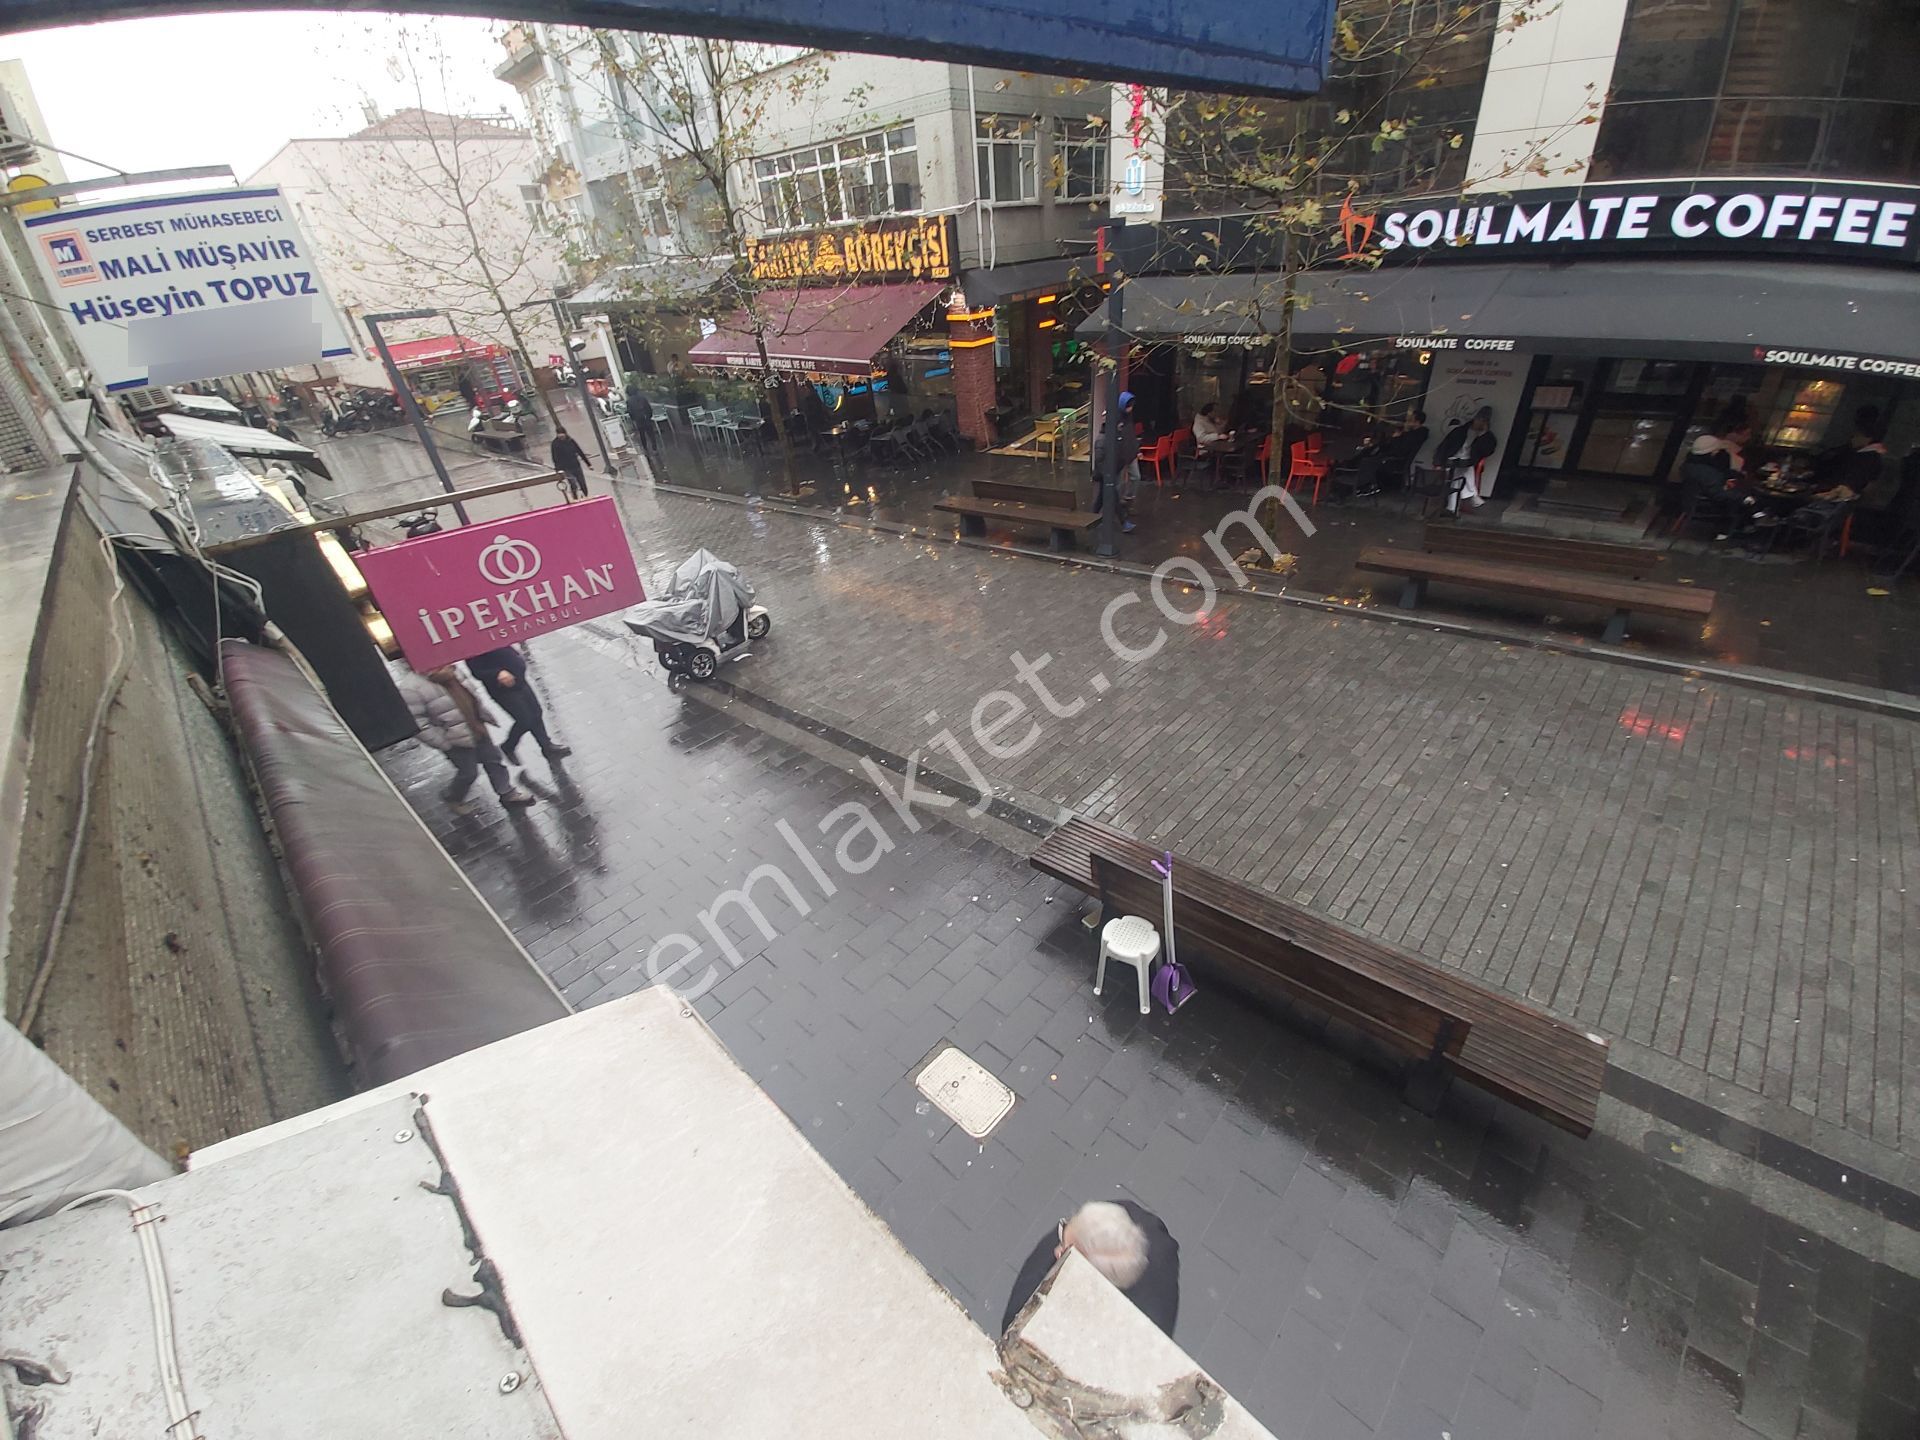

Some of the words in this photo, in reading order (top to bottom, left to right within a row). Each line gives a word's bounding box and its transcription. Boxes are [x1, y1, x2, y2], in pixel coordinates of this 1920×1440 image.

[86, 220, 165, 243] SERBEST
[171, 205, 284, 233] MÜHASEBECİ
[1379, 195, 1663, 251] SOULMATE
[1669, 193, 1918, 249] COFFEE
[98, 246, 172, 281] MALİ
[174, 235, 300, 269] MÜŞAVİR
[844, 214, 949, 277] BÖREKÇİSİ
[69, 285, 205, 325] Hüseyin
[207, 271, 318, 303] TOPUZ
[1183, 335, 1227, 345] SOULMATE
[1395, 338, 1458, 349] SOULMATE
[1464, 338, 1515, 351] COFFEE
[1764, 349, 1859, 370] SOULMATE
[418, 564, 615, 646] İPEKHAN
